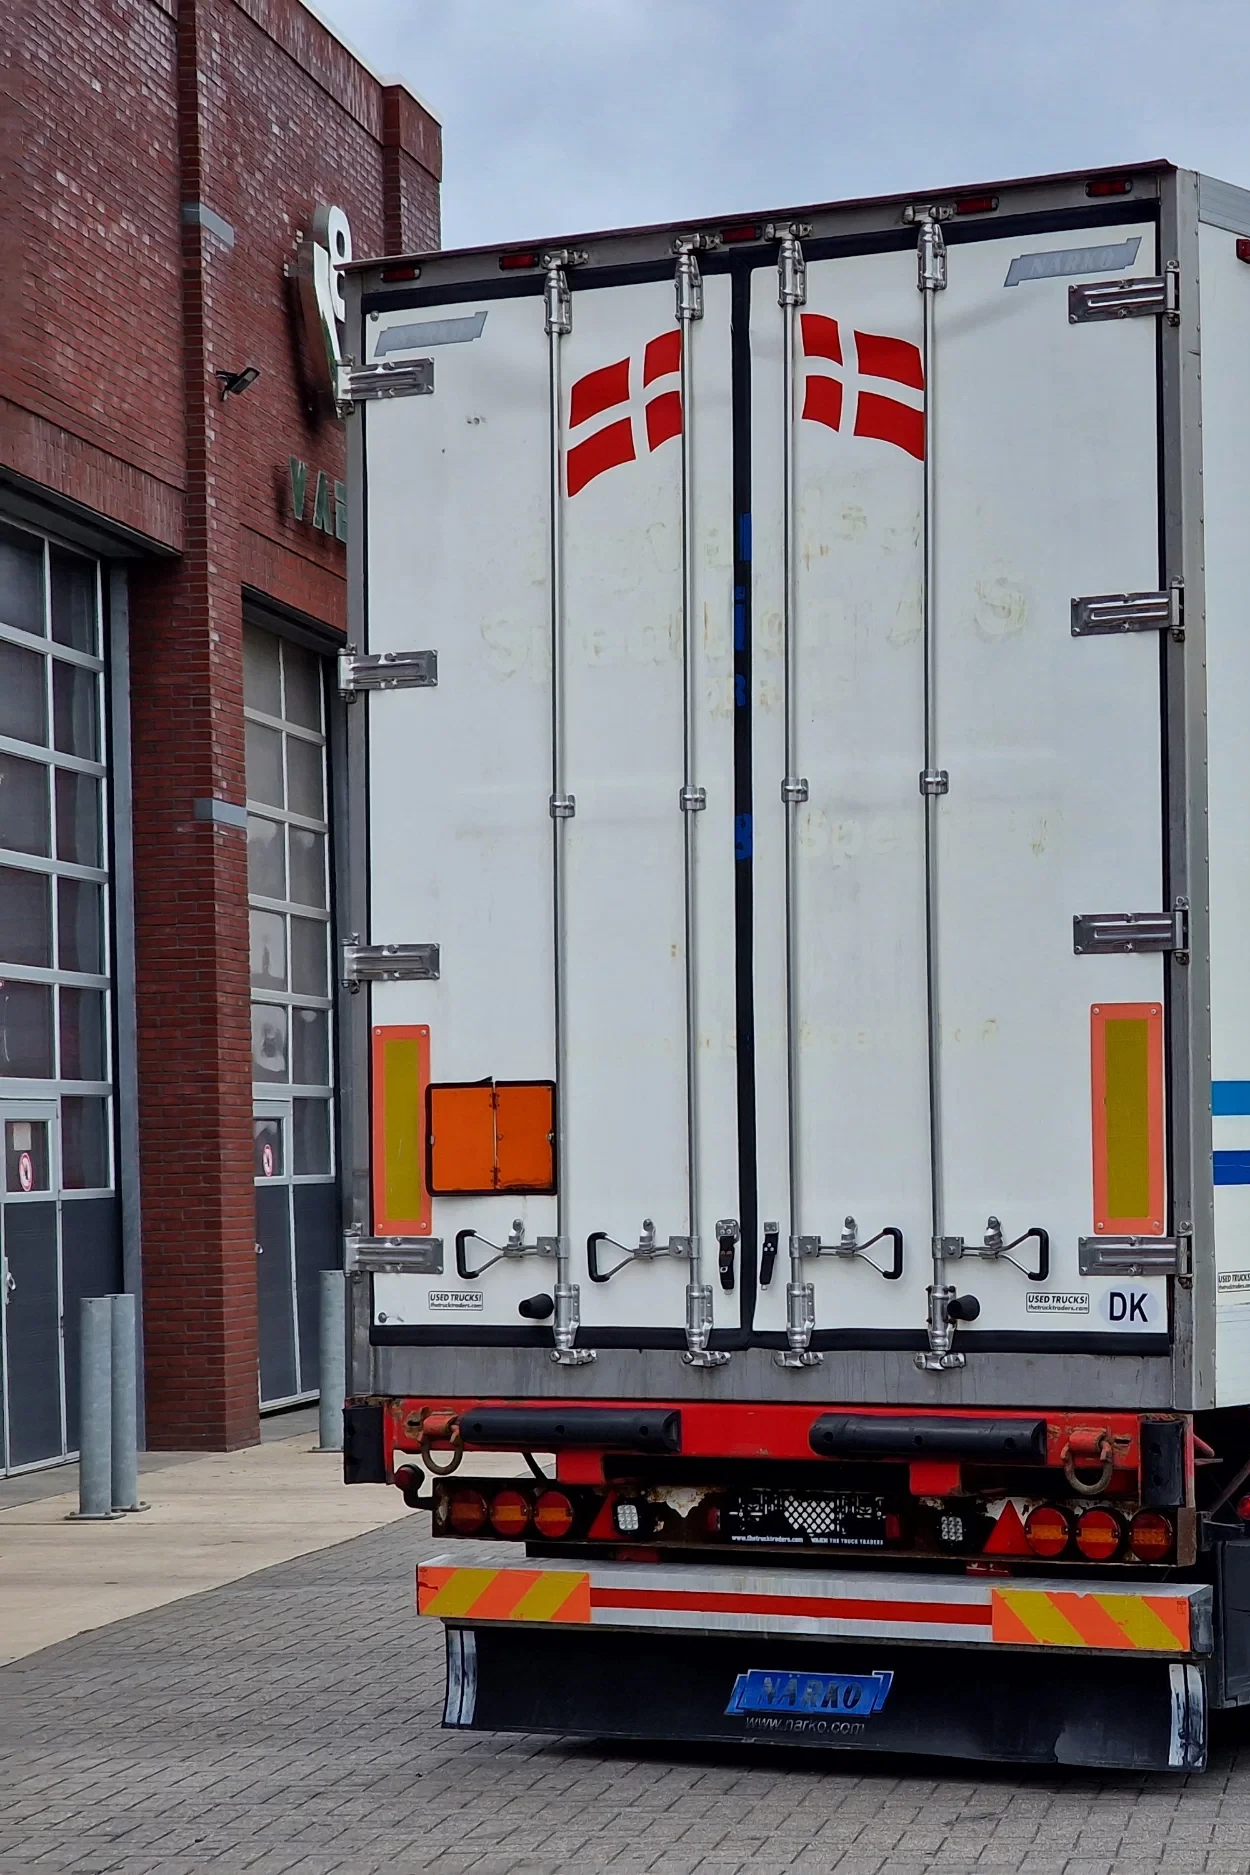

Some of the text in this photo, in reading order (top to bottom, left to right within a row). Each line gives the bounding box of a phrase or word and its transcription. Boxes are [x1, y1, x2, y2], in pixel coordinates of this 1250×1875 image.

[430, 1293, 482, 1302] USED TRUCKS!
[1028, 1294, 1088, 1304] USED TRUCKS!
[1028, 1304, 1088, 1312] thetrucktraders.com
[1109, 1291, 1149, 1323] DK
[745, 1716, 865, 1736] www.narko.com
